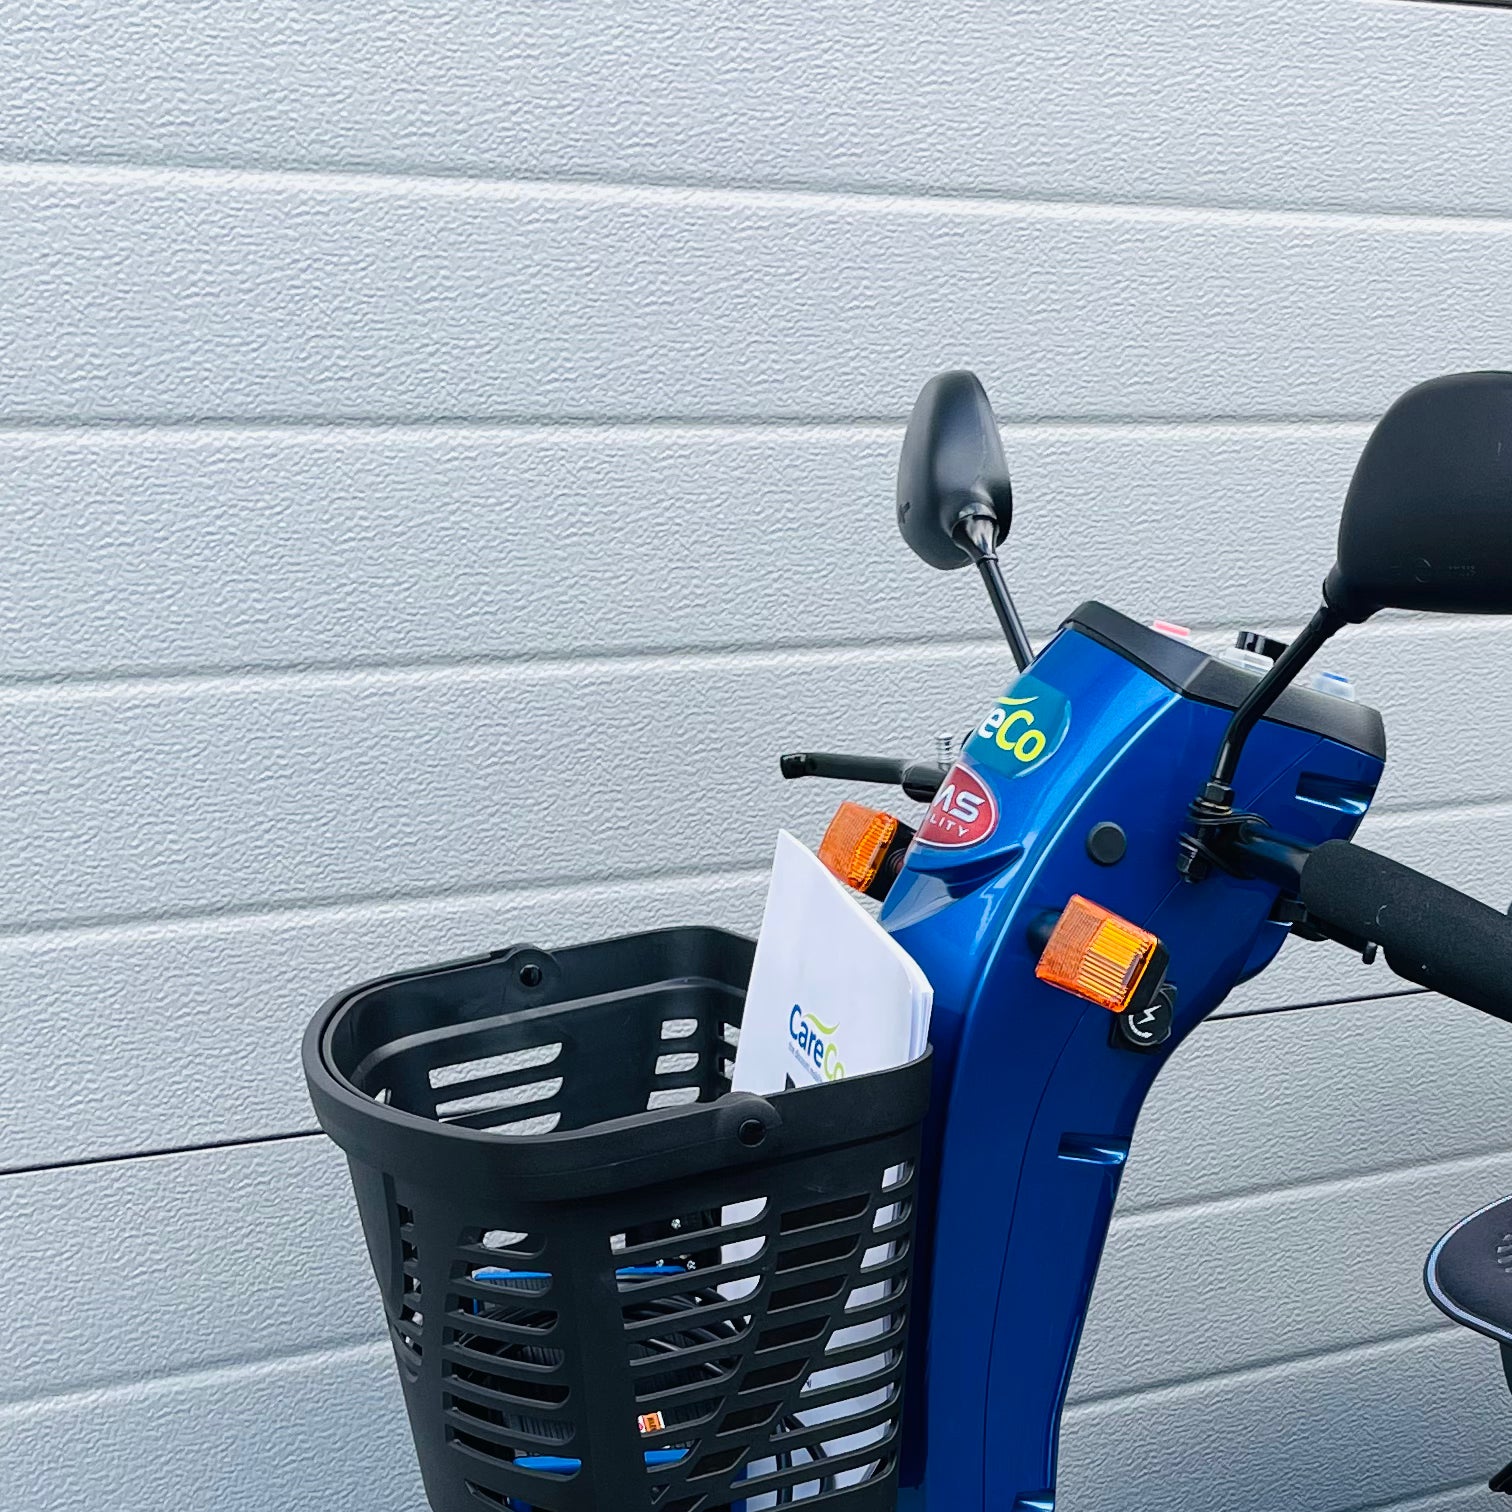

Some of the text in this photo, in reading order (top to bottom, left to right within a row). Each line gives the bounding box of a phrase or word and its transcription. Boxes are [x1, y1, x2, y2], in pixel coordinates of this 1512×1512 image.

[977, 707, 1047, 763] eCo
[932, 783, 986, 823] AS
[928, 815, 969, 838] LITY
